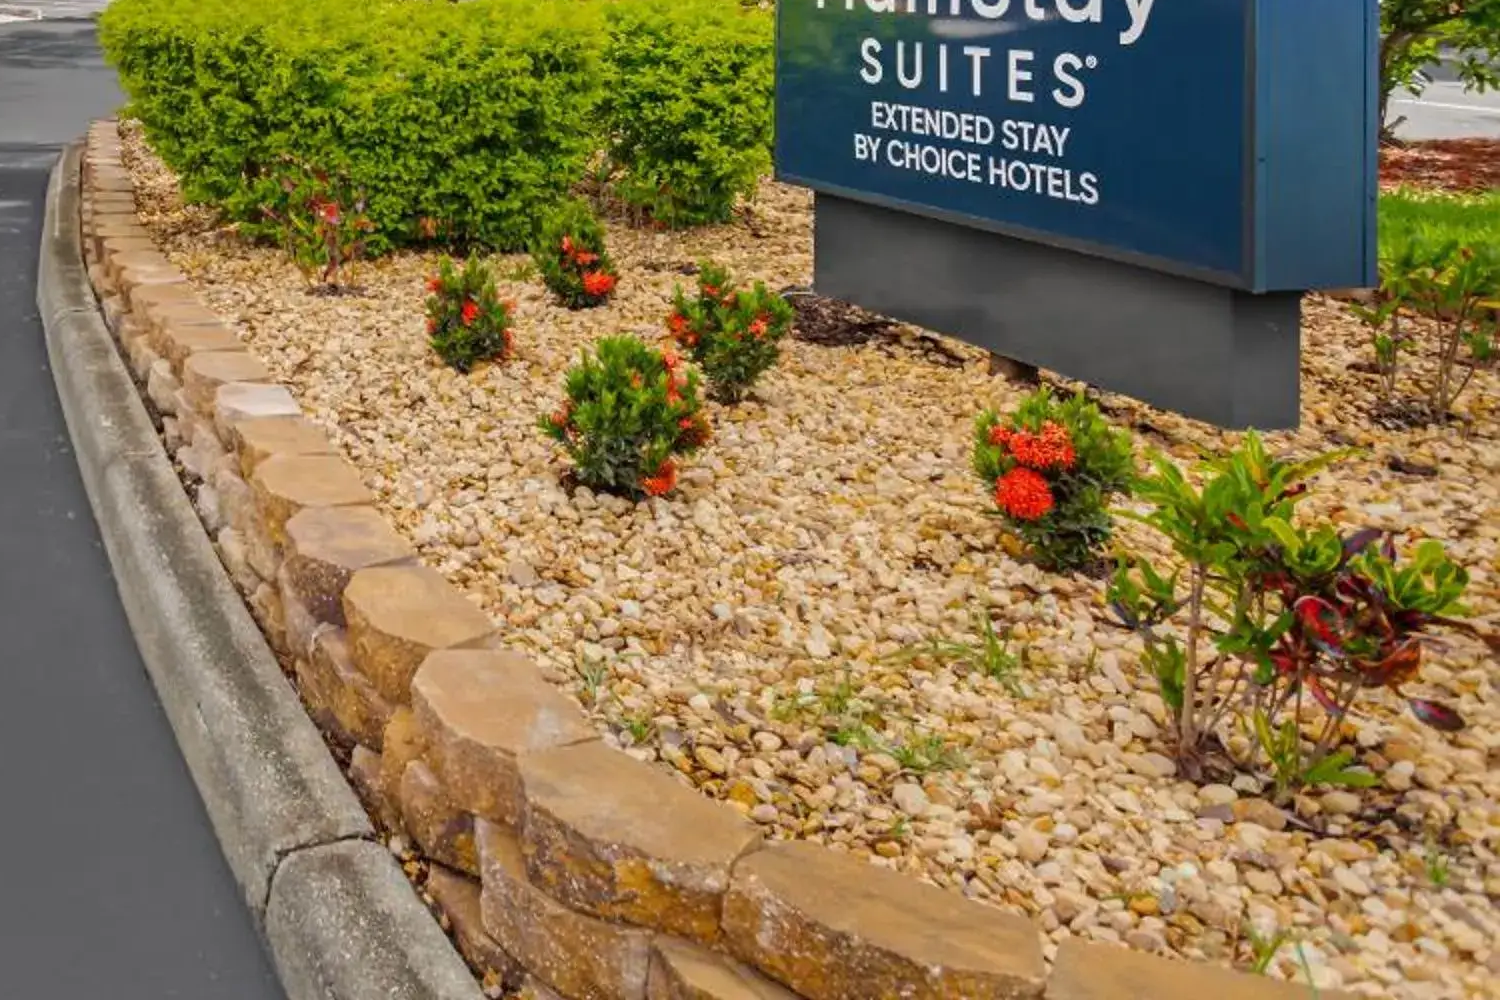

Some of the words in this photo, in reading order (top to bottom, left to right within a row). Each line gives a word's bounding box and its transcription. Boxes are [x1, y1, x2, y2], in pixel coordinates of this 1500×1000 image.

[871, 101, 995, 145] EXTENDED
[1001, 119, 1071, 157] STAY
[854, 133, 882, 162] BY
[886, 139, 982, 183] CHOICE
[988, 156, 1099, 205] HOTELS
